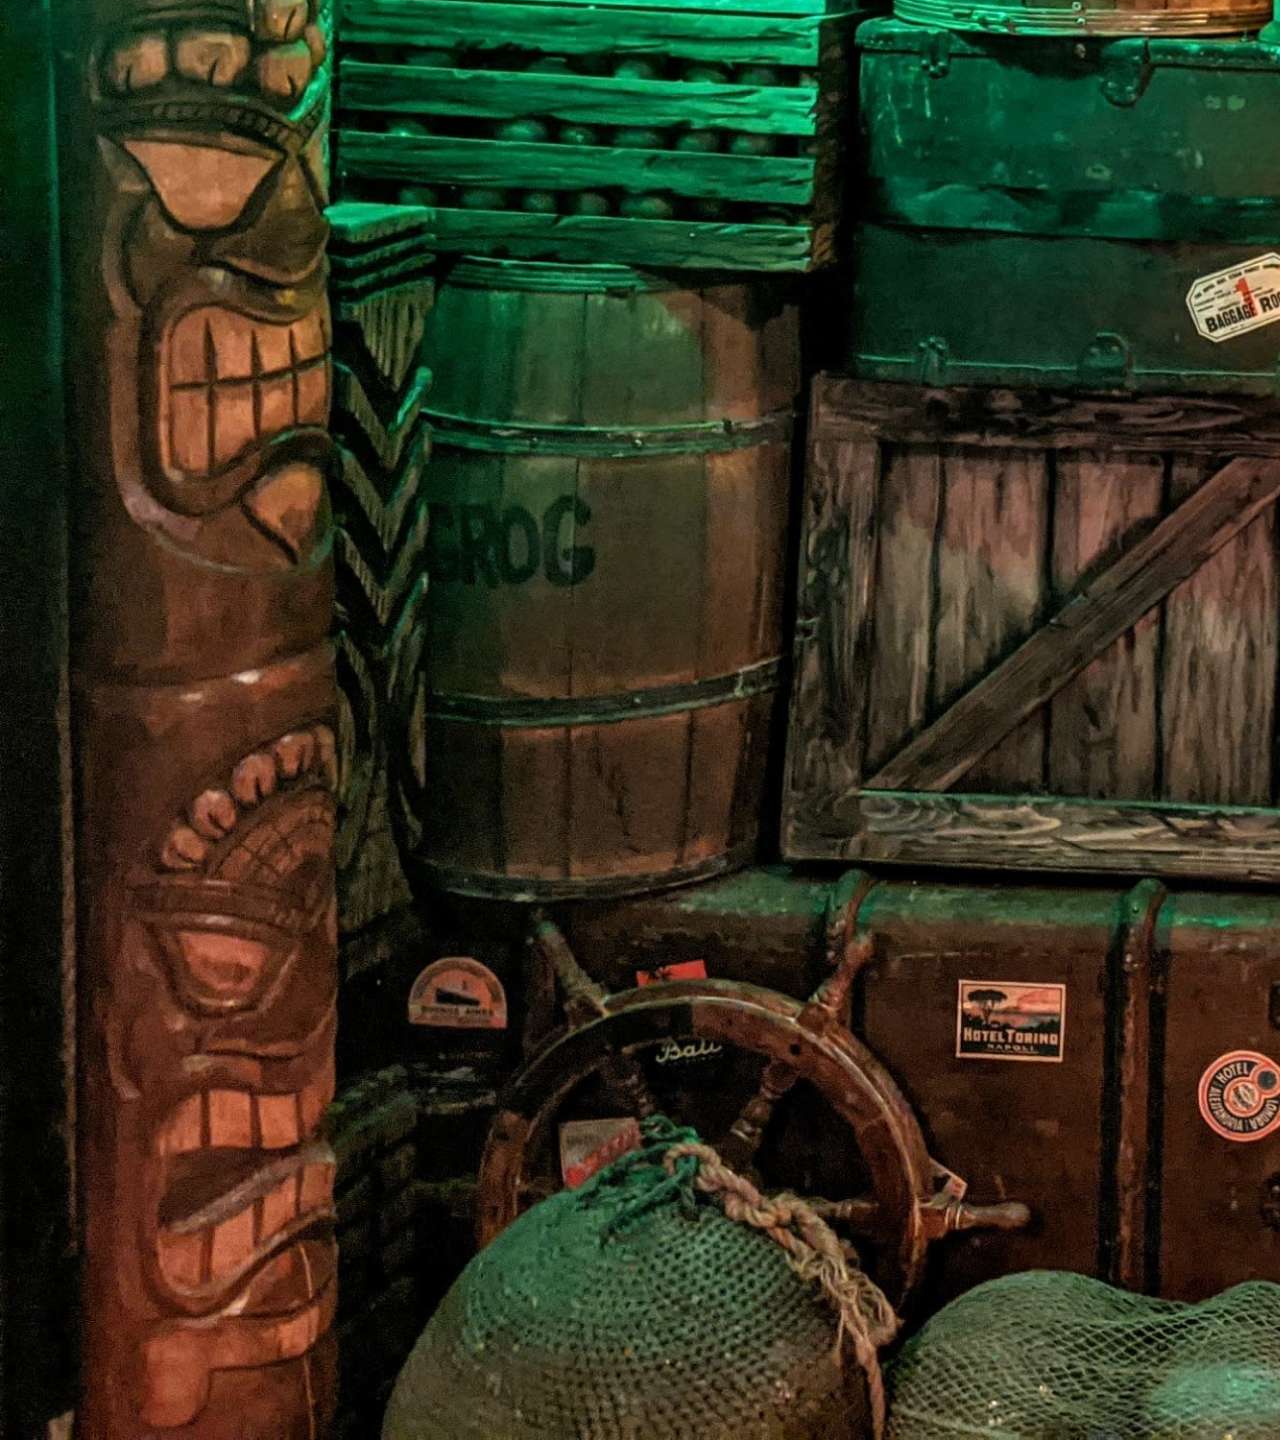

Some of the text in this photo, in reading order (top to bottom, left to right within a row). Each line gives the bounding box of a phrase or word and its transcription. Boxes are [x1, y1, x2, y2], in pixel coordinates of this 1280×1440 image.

[1204, 301, 1258, 333] BAGGAGE
[963, 1027, 1059, 1045] HOTEL TORINO
[986, 1043, 1035, 1052] NAPOLI
[1216, 1062, 1249, 1083] HOTEL
